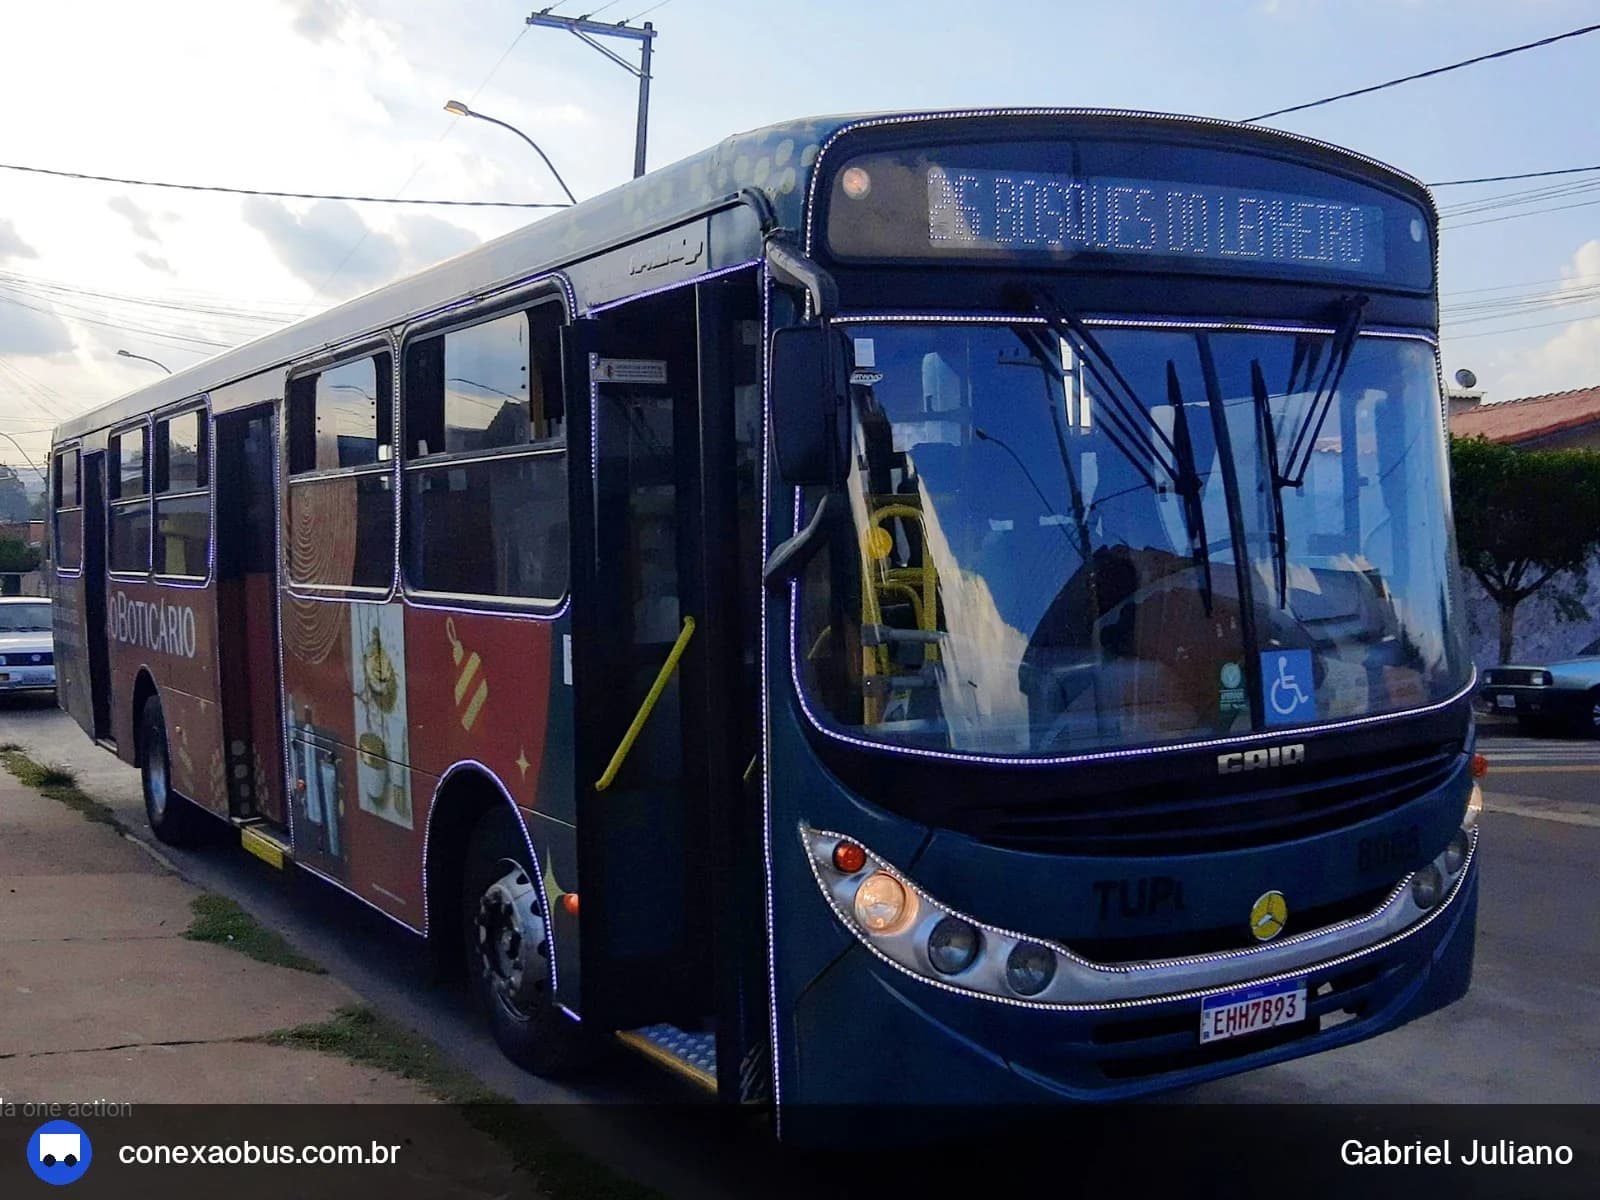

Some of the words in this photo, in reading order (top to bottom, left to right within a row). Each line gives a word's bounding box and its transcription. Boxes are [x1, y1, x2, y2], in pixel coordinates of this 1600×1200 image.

[994, 177, 1156, 250] BOSQUES
[1167, 191, 1209, 253] DO
[1219, 196, 1364, 262] LENHEIRO
[1217, 744, 1305, 775] CAIO
[1213, 993, 1297, 1036] EHH7B93
